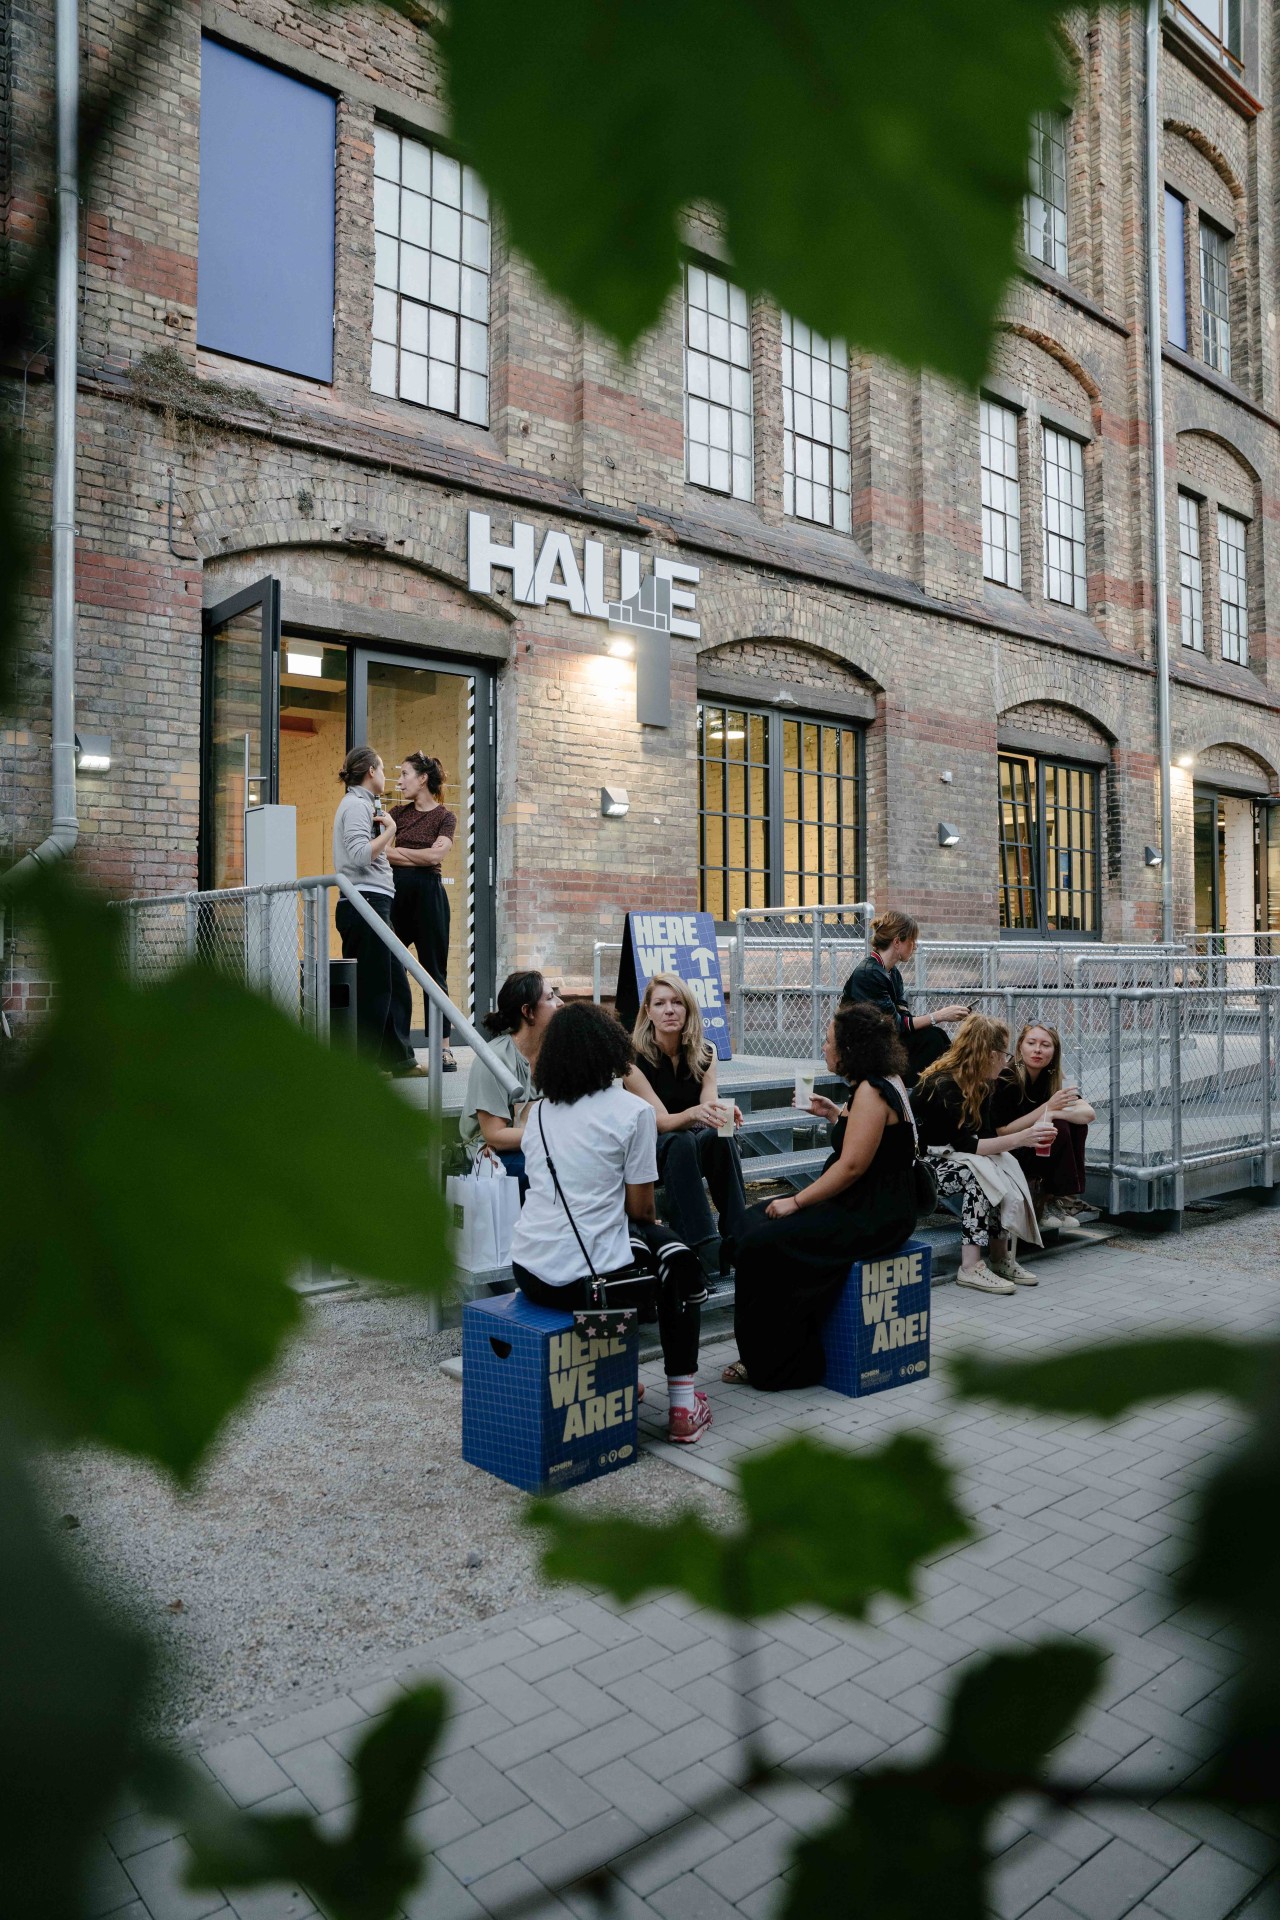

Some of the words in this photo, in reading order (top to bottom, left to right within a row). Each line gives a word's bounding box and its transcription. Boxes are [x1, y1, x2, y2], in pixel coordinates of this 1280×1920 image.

[468, 509, 701, 639] HALLE
[633, 915, 700, 946] HERE
[637, 947, 680, 977] WE
[687, 978, 722, 1008] RE
[861, 1252, 923, 1296] HERE
[861, 1288, 899, 1326] WE
[871, 1310, 928, 1355] ARE!
[548, 1362, 597, 1410] WE
[562, 1385, 634, 1443] ARE!
